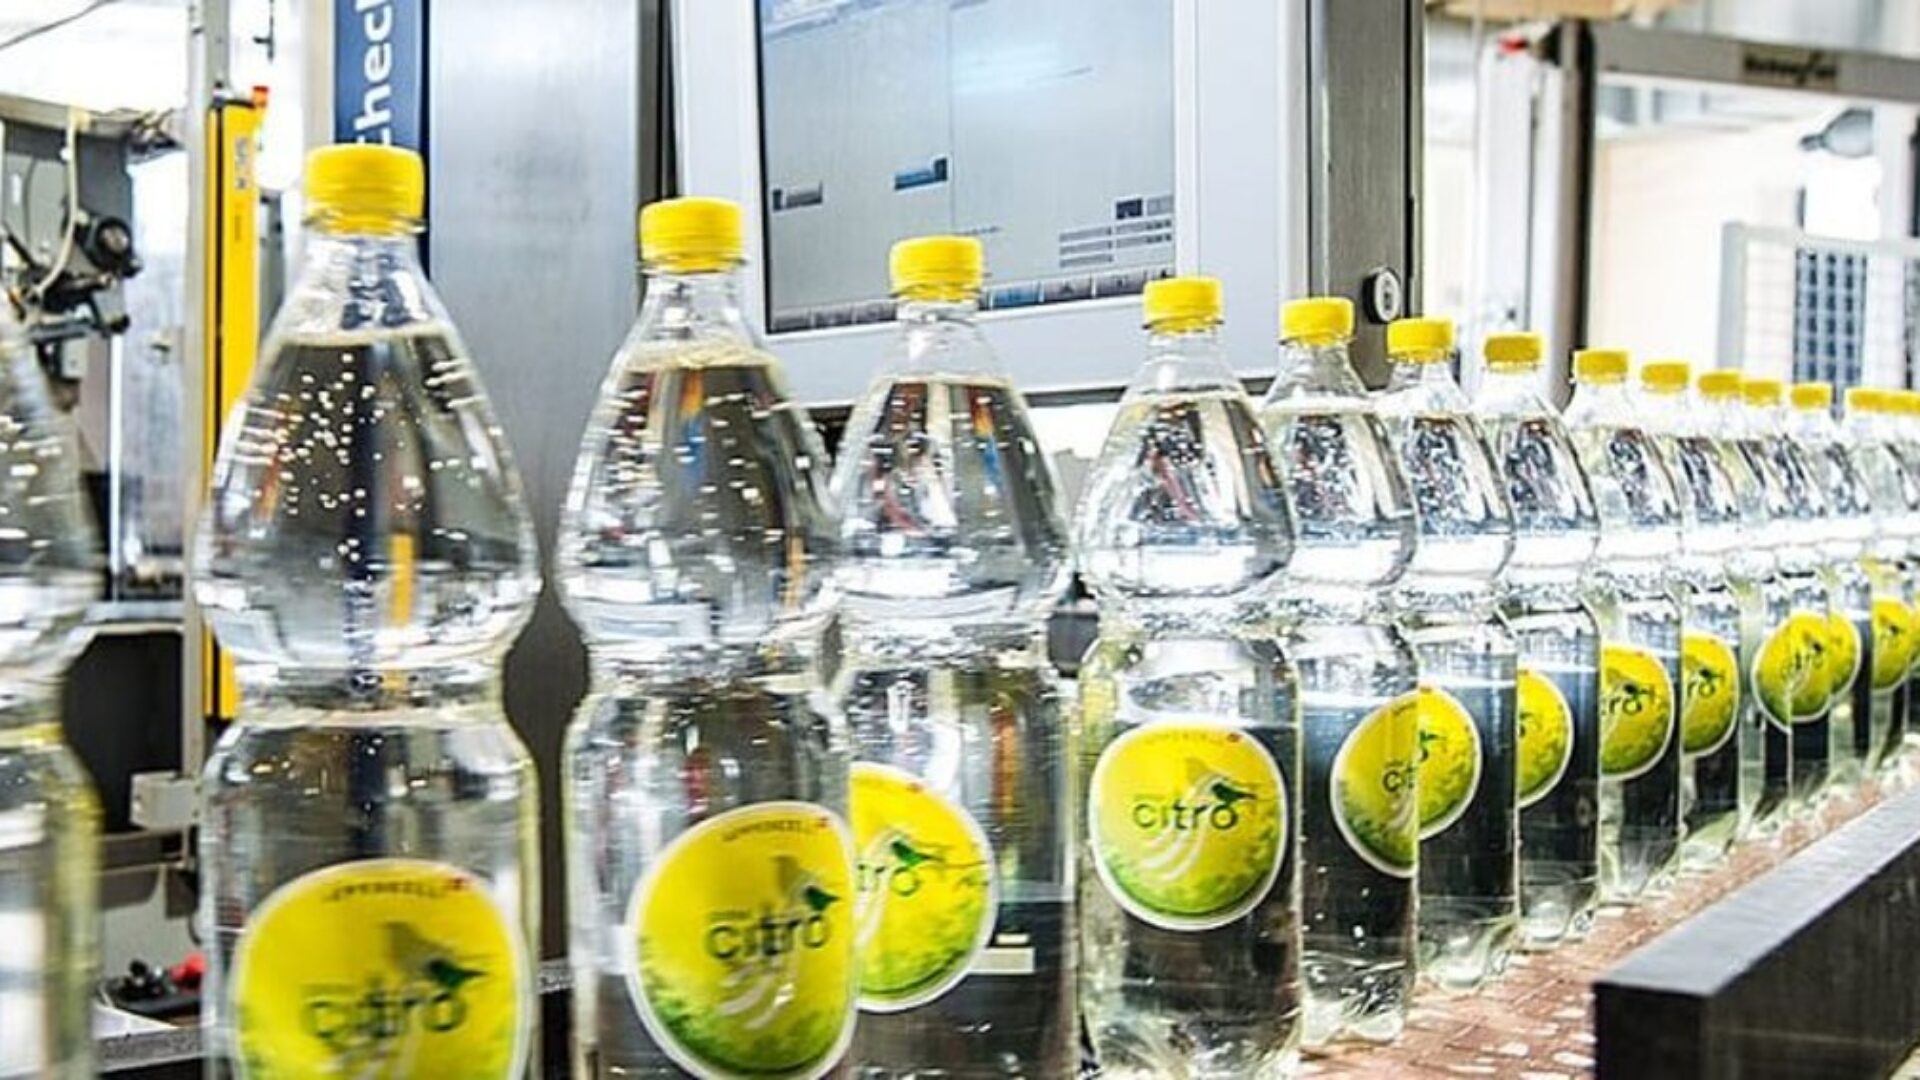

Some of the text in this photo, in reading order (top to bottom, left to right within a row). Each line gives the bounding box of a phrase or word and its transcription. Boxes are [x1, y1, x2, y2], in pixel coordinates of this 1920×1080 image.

[1132, 797, 1239, 830] citro
[705, 907, 830, 960] citro
[301, 982, 468, 1040] citro
